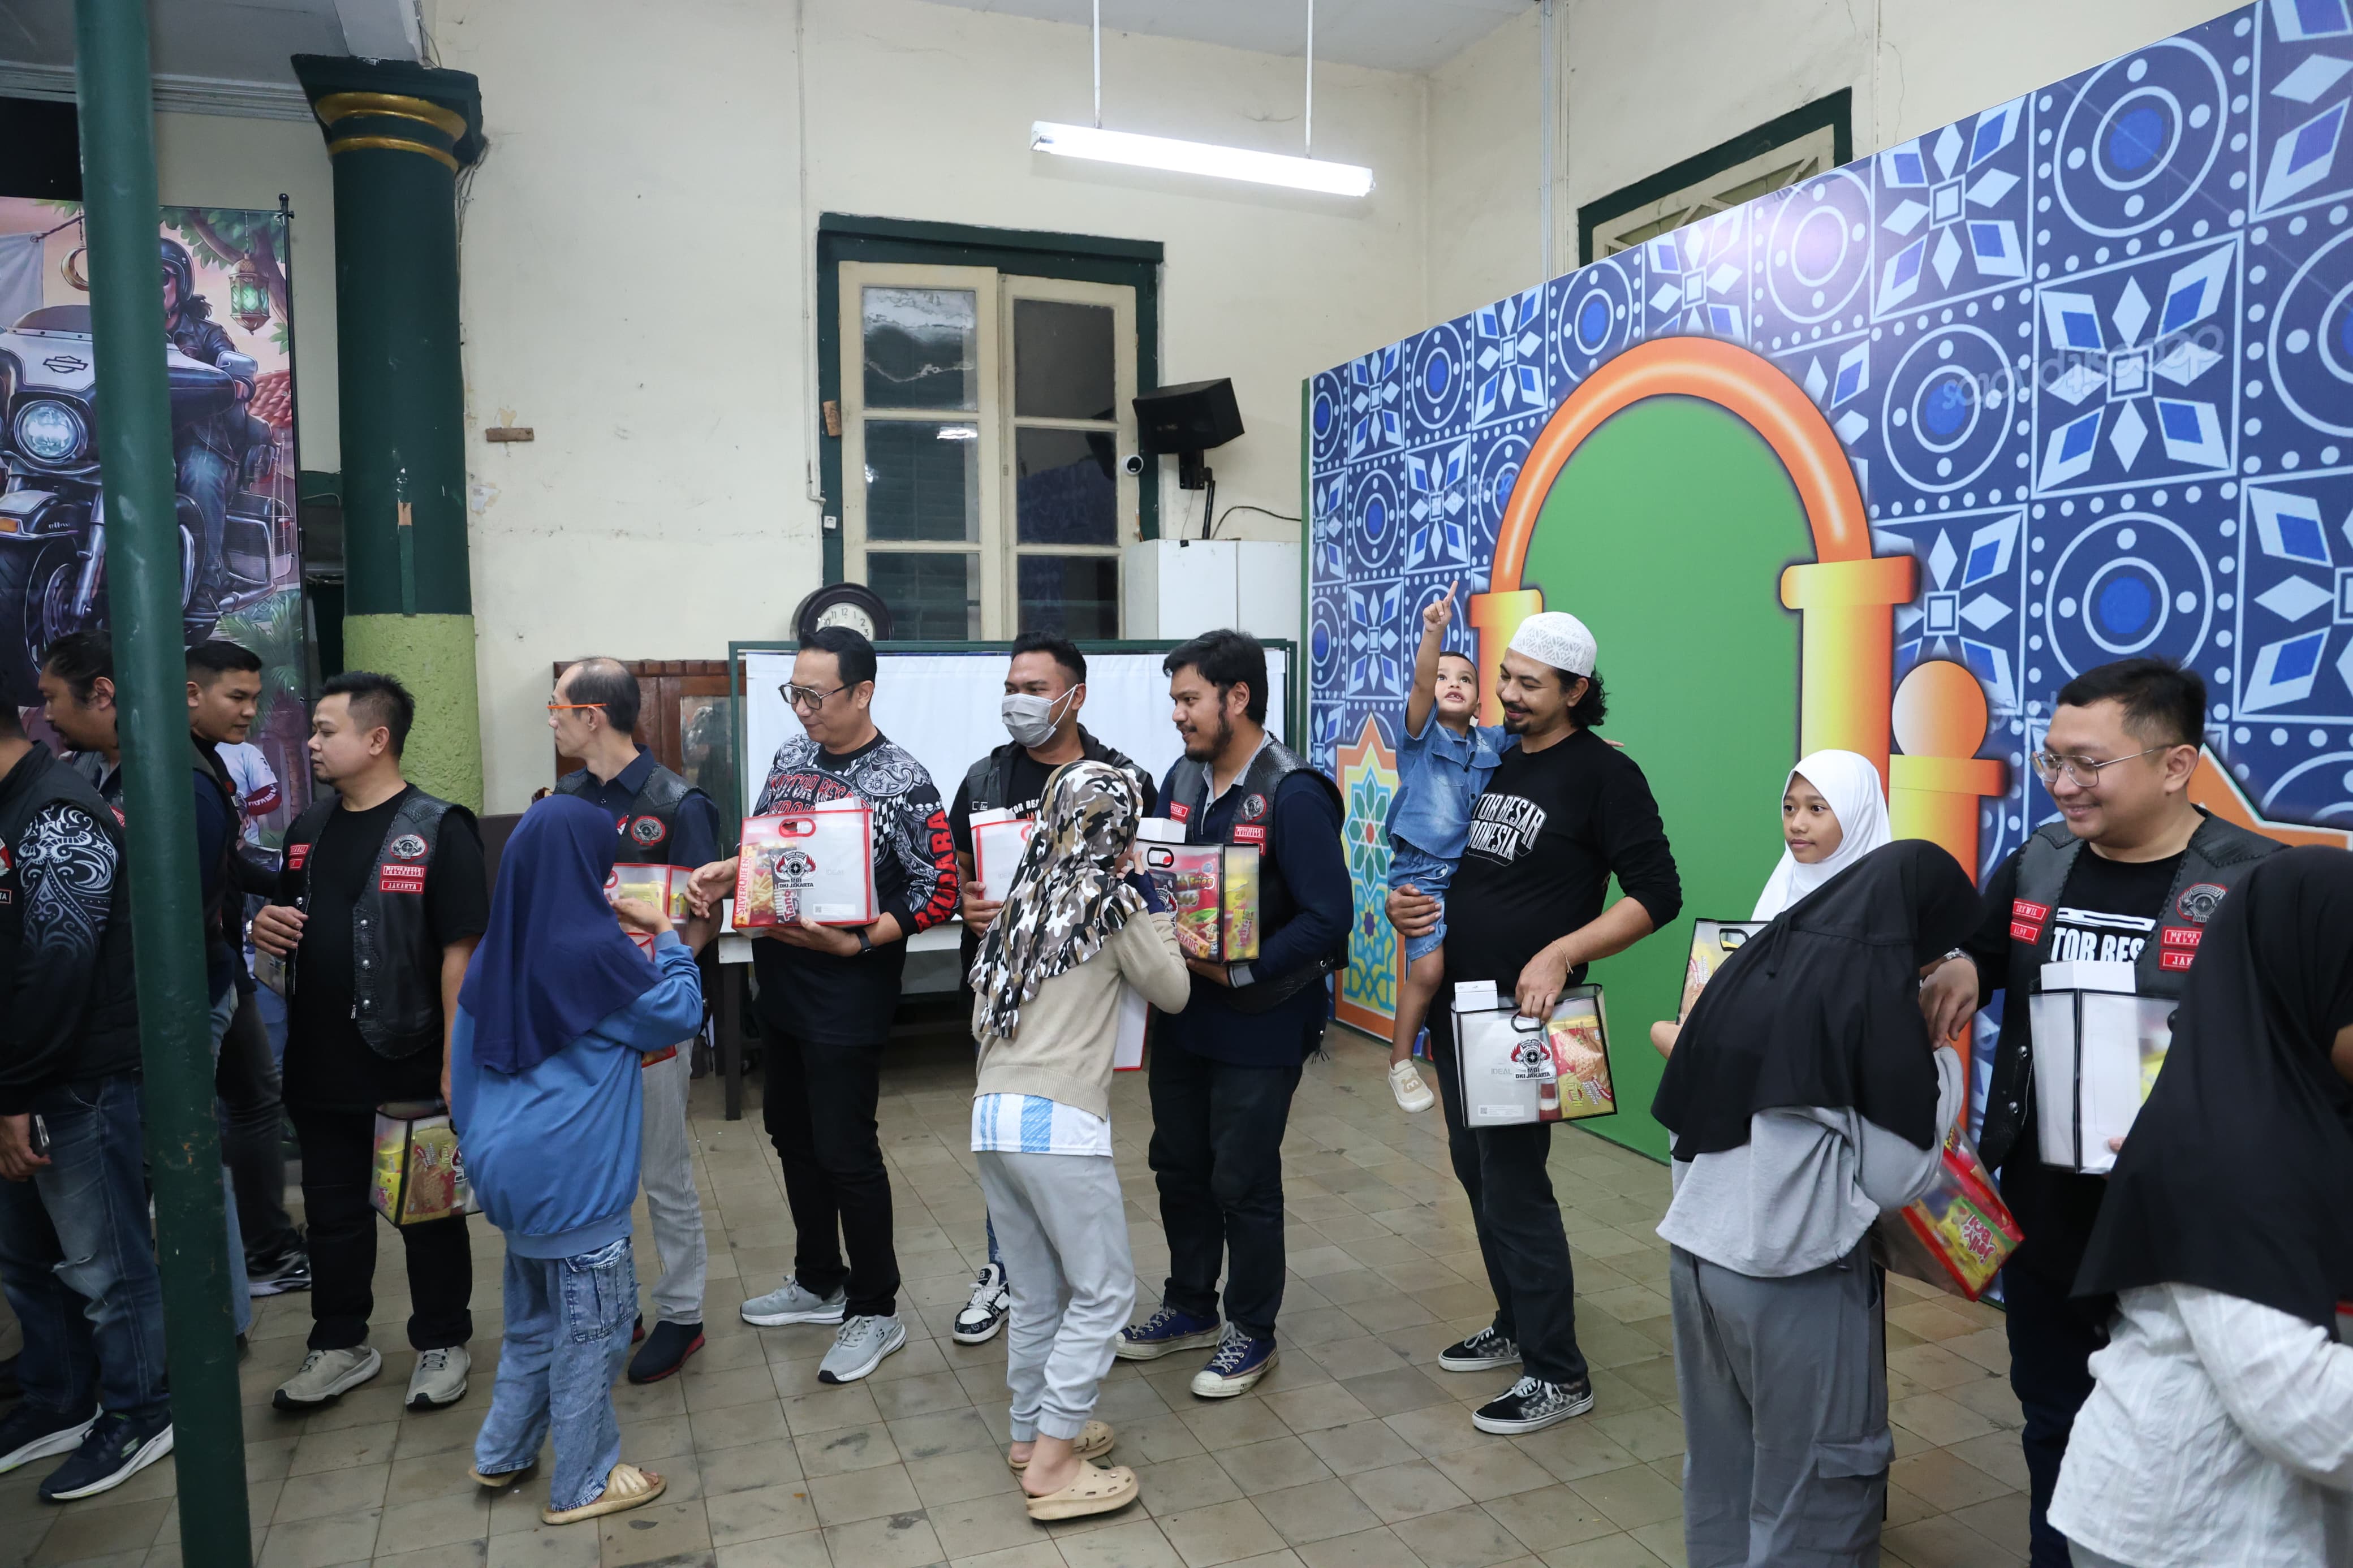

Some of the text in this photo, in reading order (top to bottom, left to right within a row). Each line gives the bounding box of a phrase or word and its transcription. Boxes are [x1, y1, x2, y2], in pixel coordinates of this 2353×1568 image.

[1025, 798, 1040, 809] BES
[1472, 793, 1546, 850] TOR BESAR
[1467, 820, 1520, 861] DONESIA
[783, 889, 796, 920] Tang
[2050, 927, 2145, 962] TOR BES
[2172, 956, 2194, 966] JAK
